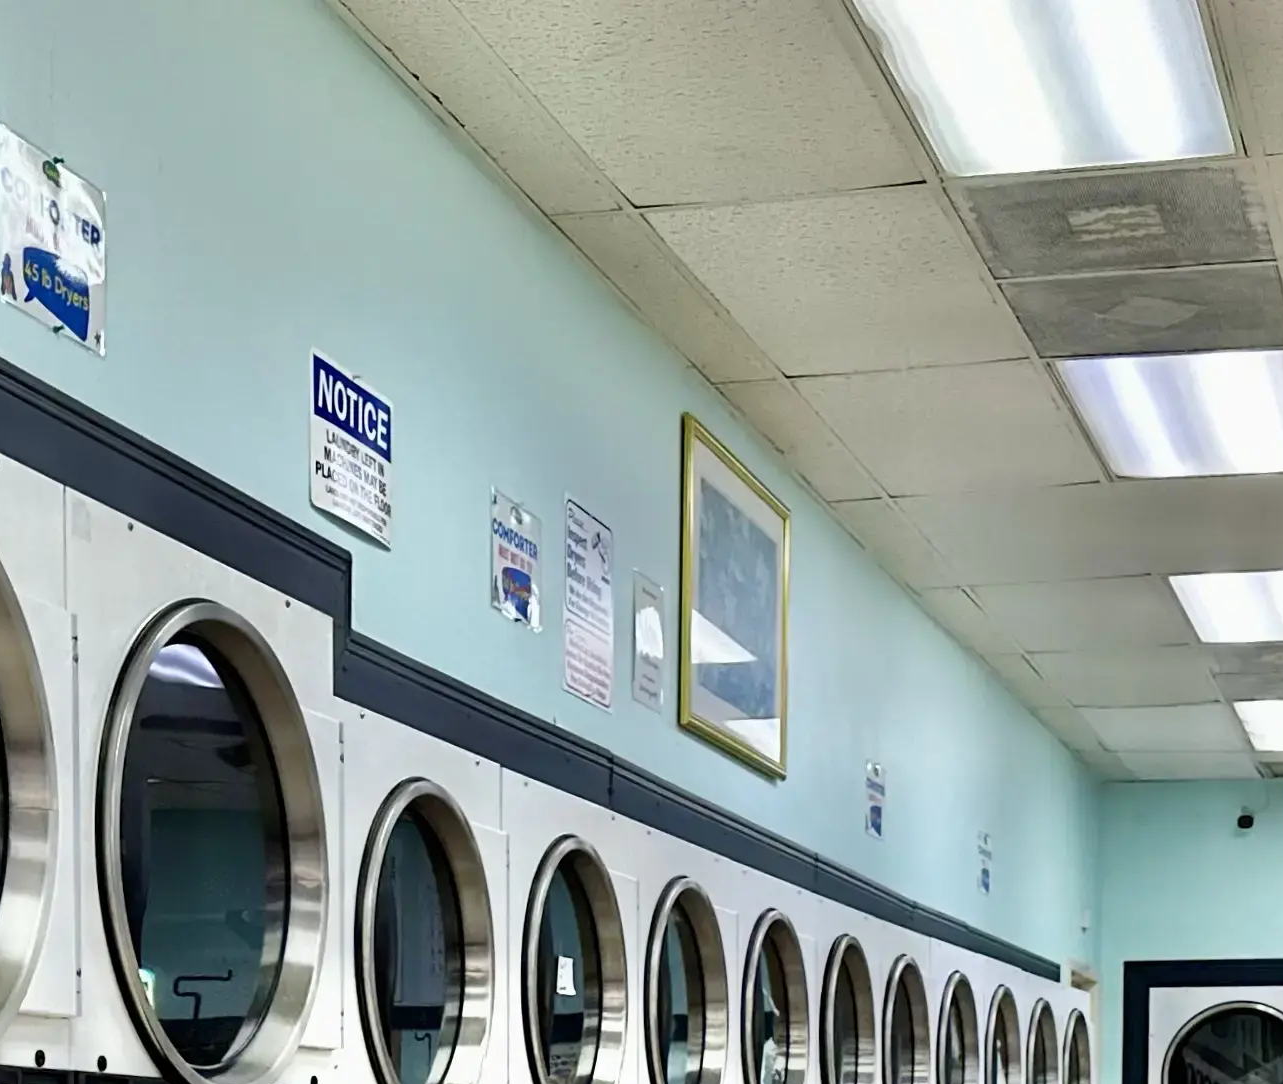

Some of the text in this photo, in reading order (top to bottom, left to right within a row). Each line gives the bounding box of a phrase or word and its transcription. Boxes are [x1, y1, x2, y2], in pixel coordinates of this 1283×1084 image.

[24, 260, 90, 311] 45 lb Dryers
[318, 369, 389, 451] NOTICE
[326, 429, 360, 460] LAUNDRY
[361, 451, 377, 472] LEFT
[315, 460, 347, 488] PLACED
[373, 493, 392, 519] FLOOR
[378, 479, 386, 497] BE
[492, 517, 538, 563] COMFORTER
